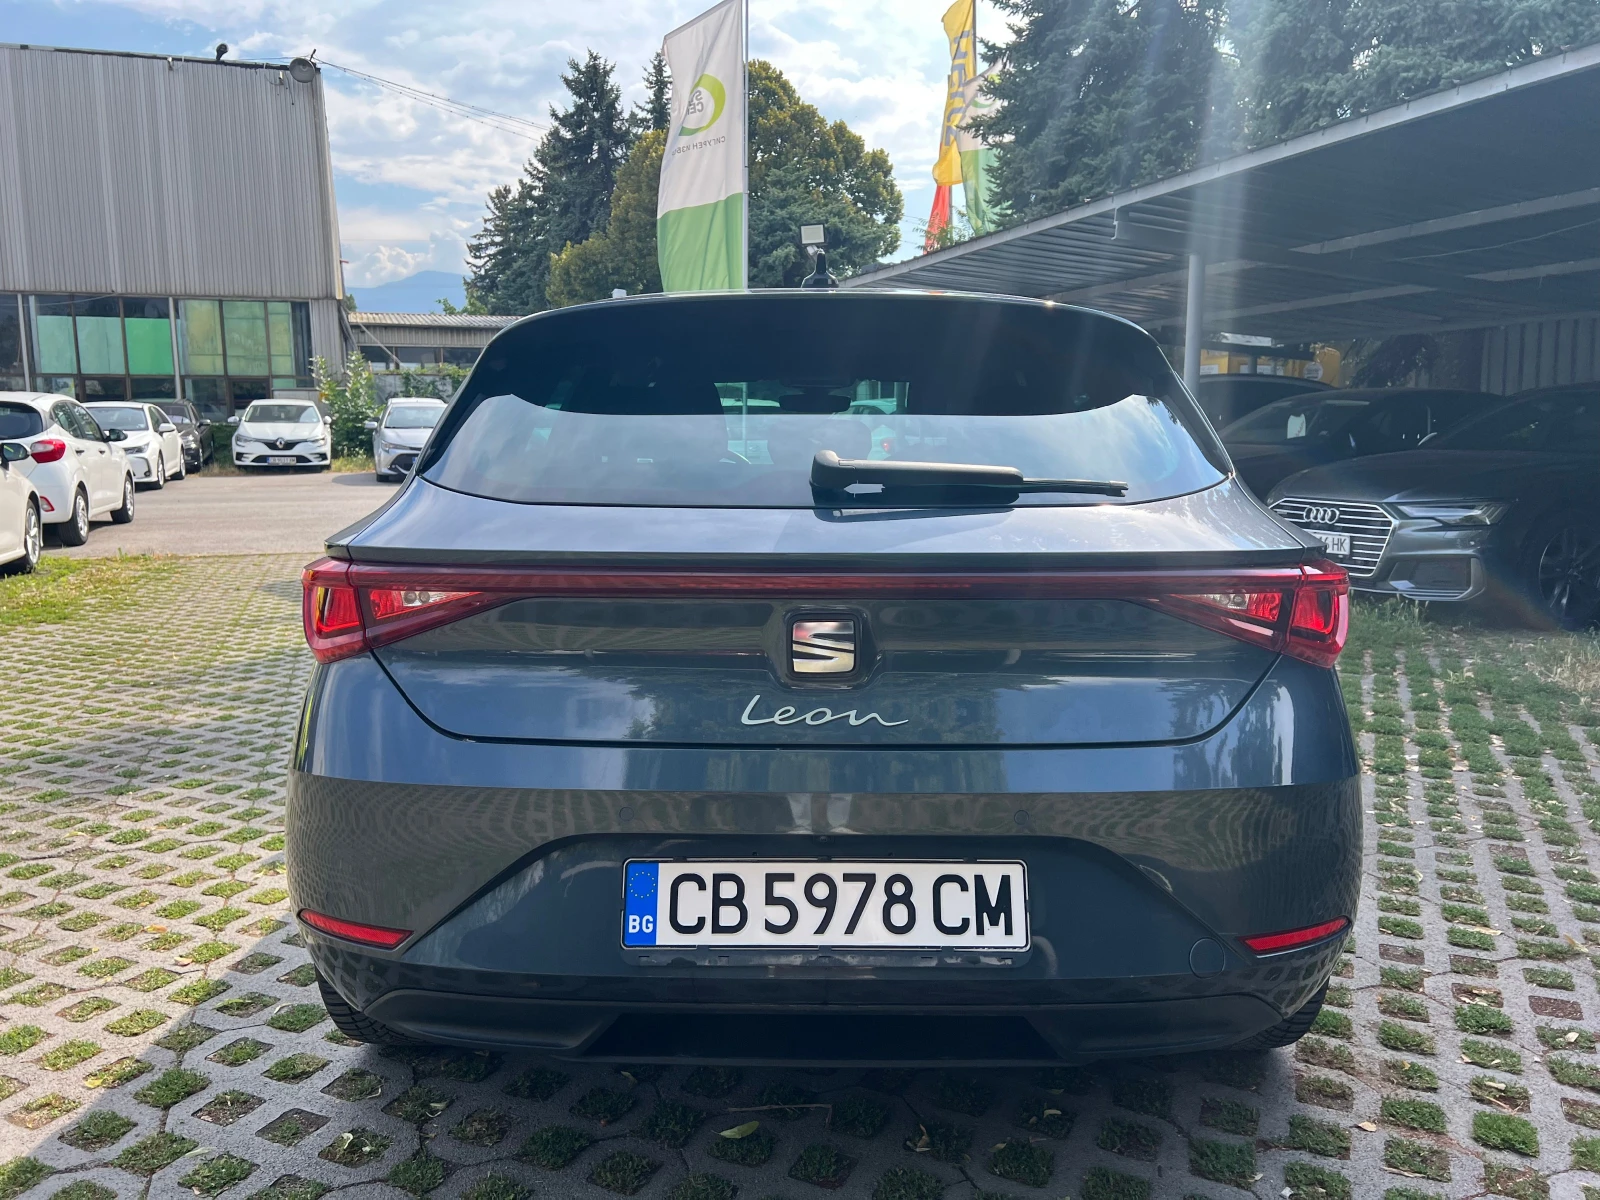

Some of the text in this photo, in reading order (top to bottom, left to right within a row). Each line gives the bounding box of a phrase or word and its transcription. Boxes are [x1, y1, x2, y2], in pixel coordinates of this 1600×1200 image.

[1332, 537, 1347, 552] HK
[740, 694, 909, 726] Leon
[669, 872, 1014, 936] CB 5978 CM
[628, 915, 654, 934] BG
